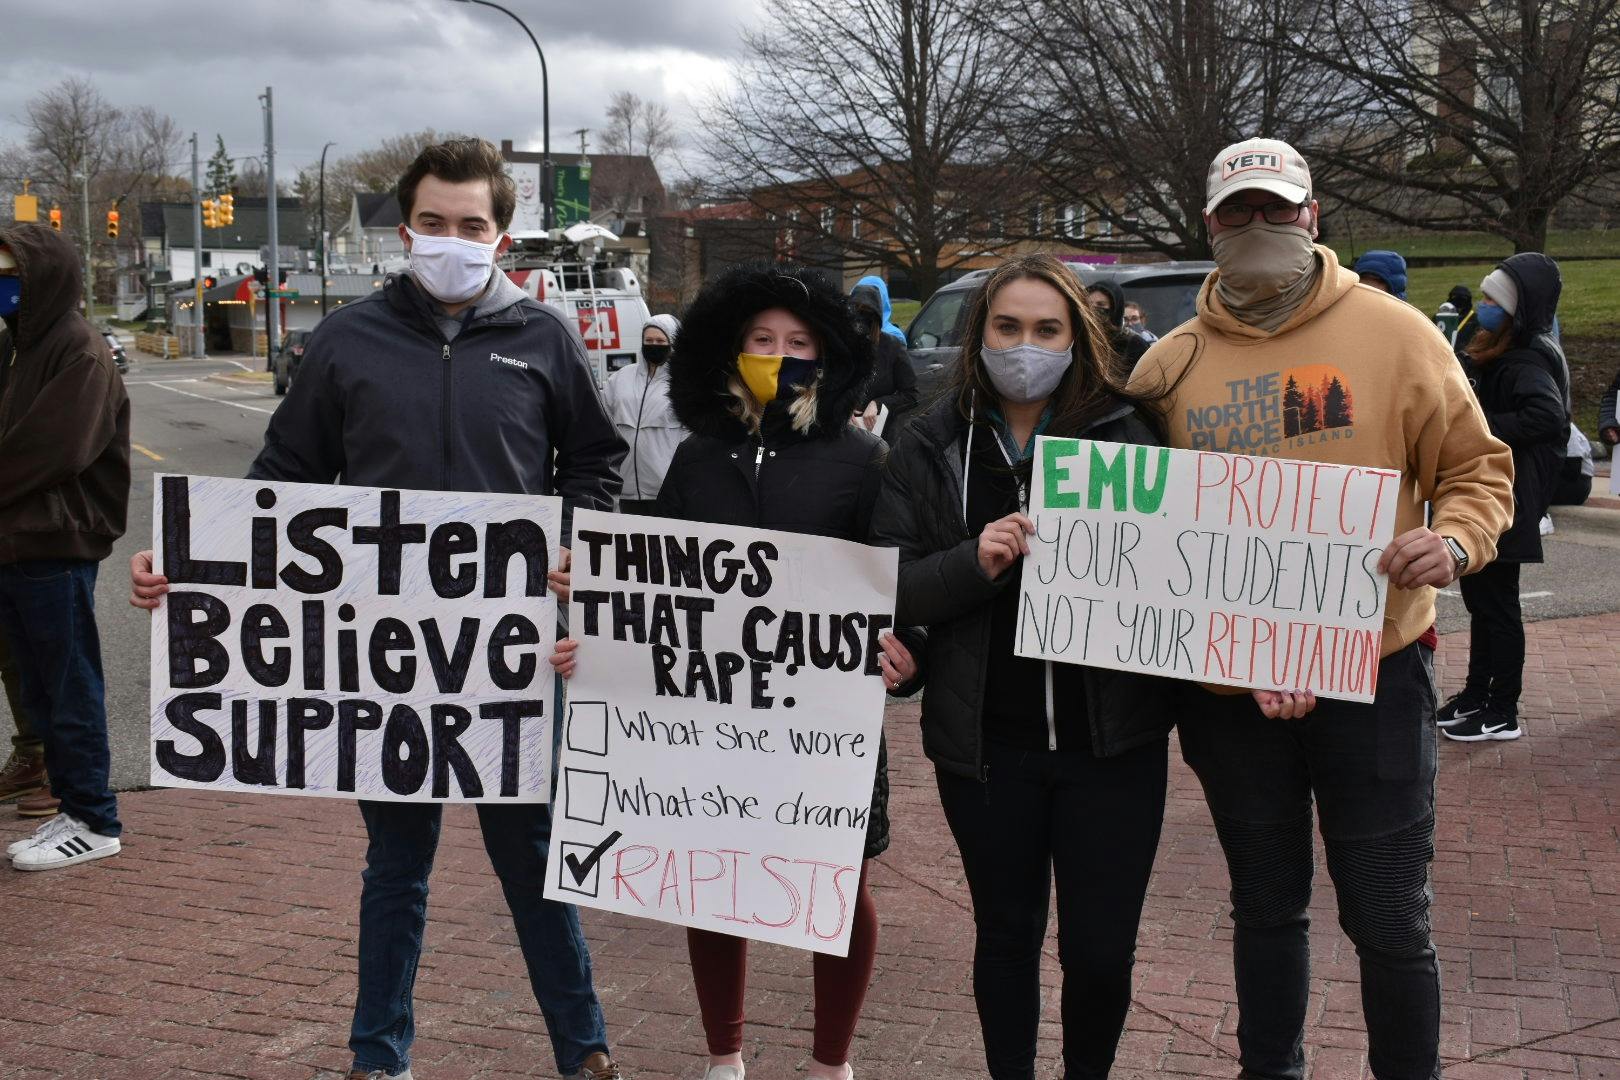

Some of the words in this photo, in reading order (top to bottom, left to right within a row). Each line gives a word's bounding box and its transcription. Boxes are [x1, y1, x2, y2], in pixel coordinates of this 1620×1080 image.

[1227, 155, 1276, 171] YETI
[490, 352, 528, 369] Preston
[582, 311, 616, 347] 4
[1186, 395, 1280, 432] NORTH
[1226, 372, 1280, 402] THE
[1192, 418, 1281, 452] PLACE
[1289, 428, 1354, 450] ISLAND
[1195, 452, 1397, 540] PROTECT
[162, 476, 549, 599] Listen
[578, 530, 778, 597] THINGS
[1036, 515, 1141, 590] YOUR
[1168, 530, 1384, 619] STUDENTS
[167, 591, 541, 694] Believe
[572, 590, 715, 650] THAT
[742, 605, 893, 676] CAUSE
[1019, 590, 1104, 660] NOT
[1116, 601, 1194, 673] YOUR
[1204, 611, 1382, 696] REPUTATION
[652, 645, 796, 709] RAPE:
[155, 692, 543, 799] SUPPORT
[615, 706, 704, 746] What
[789, 728, 866, 758] wore
[612, 777, 697, 818] What
[775, 791, 869, 830] drank
[611, 845, 857, 941] RAPISTS
